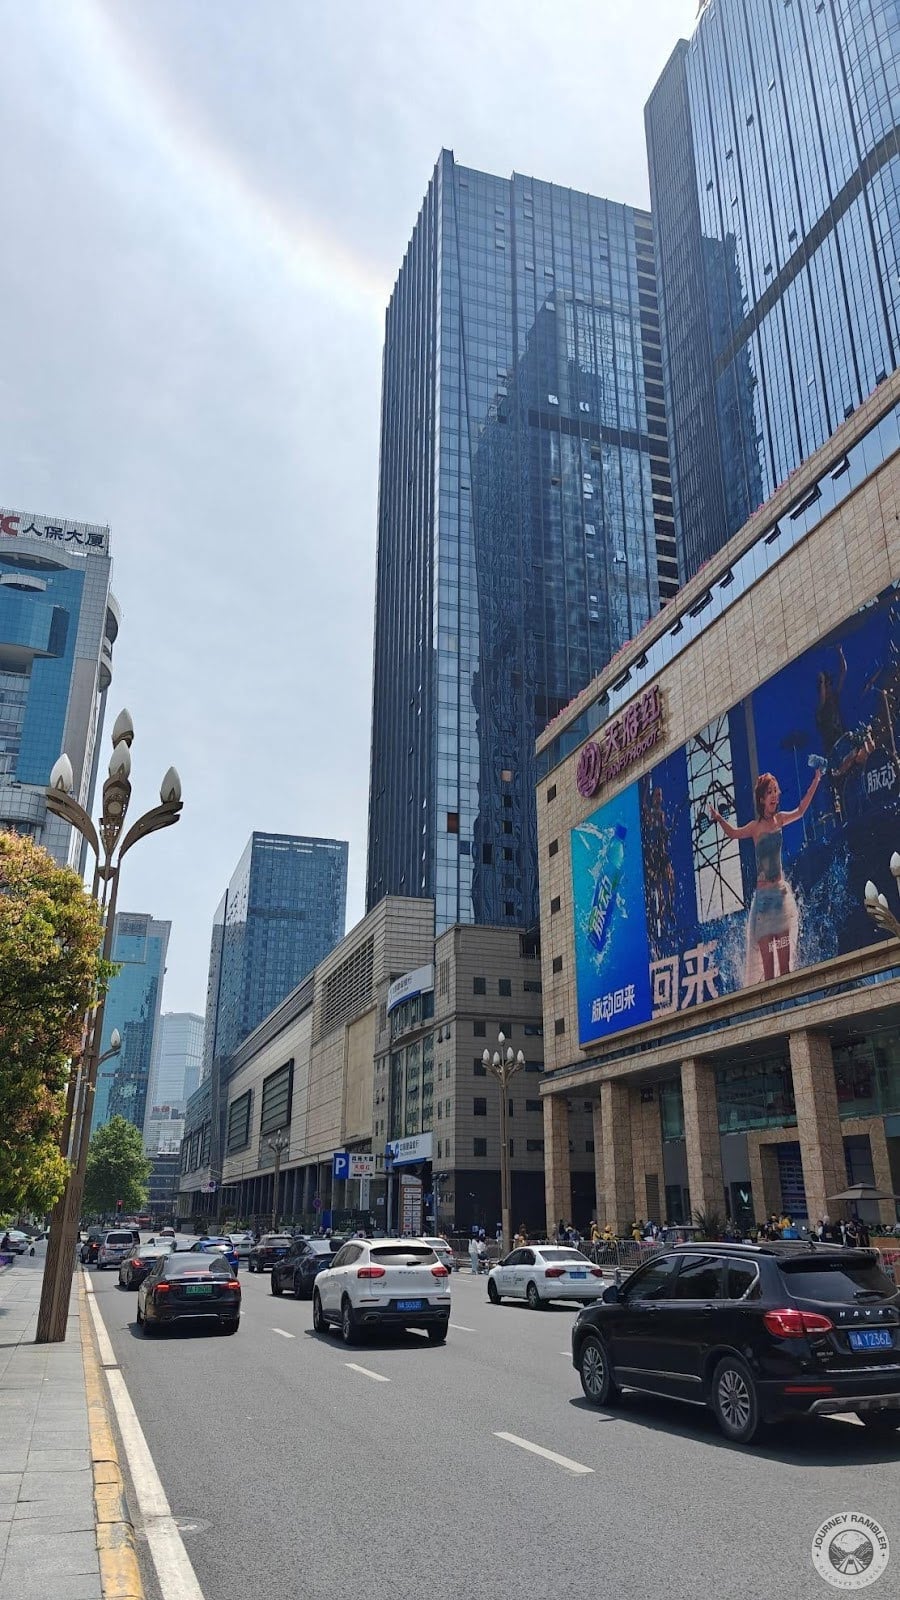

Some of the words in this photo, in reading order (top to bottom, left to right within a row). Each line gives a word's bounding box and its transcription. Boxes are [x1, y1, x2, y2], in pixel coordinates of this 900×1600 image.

[23, 522, 105, 549] 人保大厦
[867, 762, 897, 794] 脉动
[648, 939, 720, 1020] 回来
[591, 984, 636, 1024] 脉动回来
[335, 1157, 347, 1175] P
